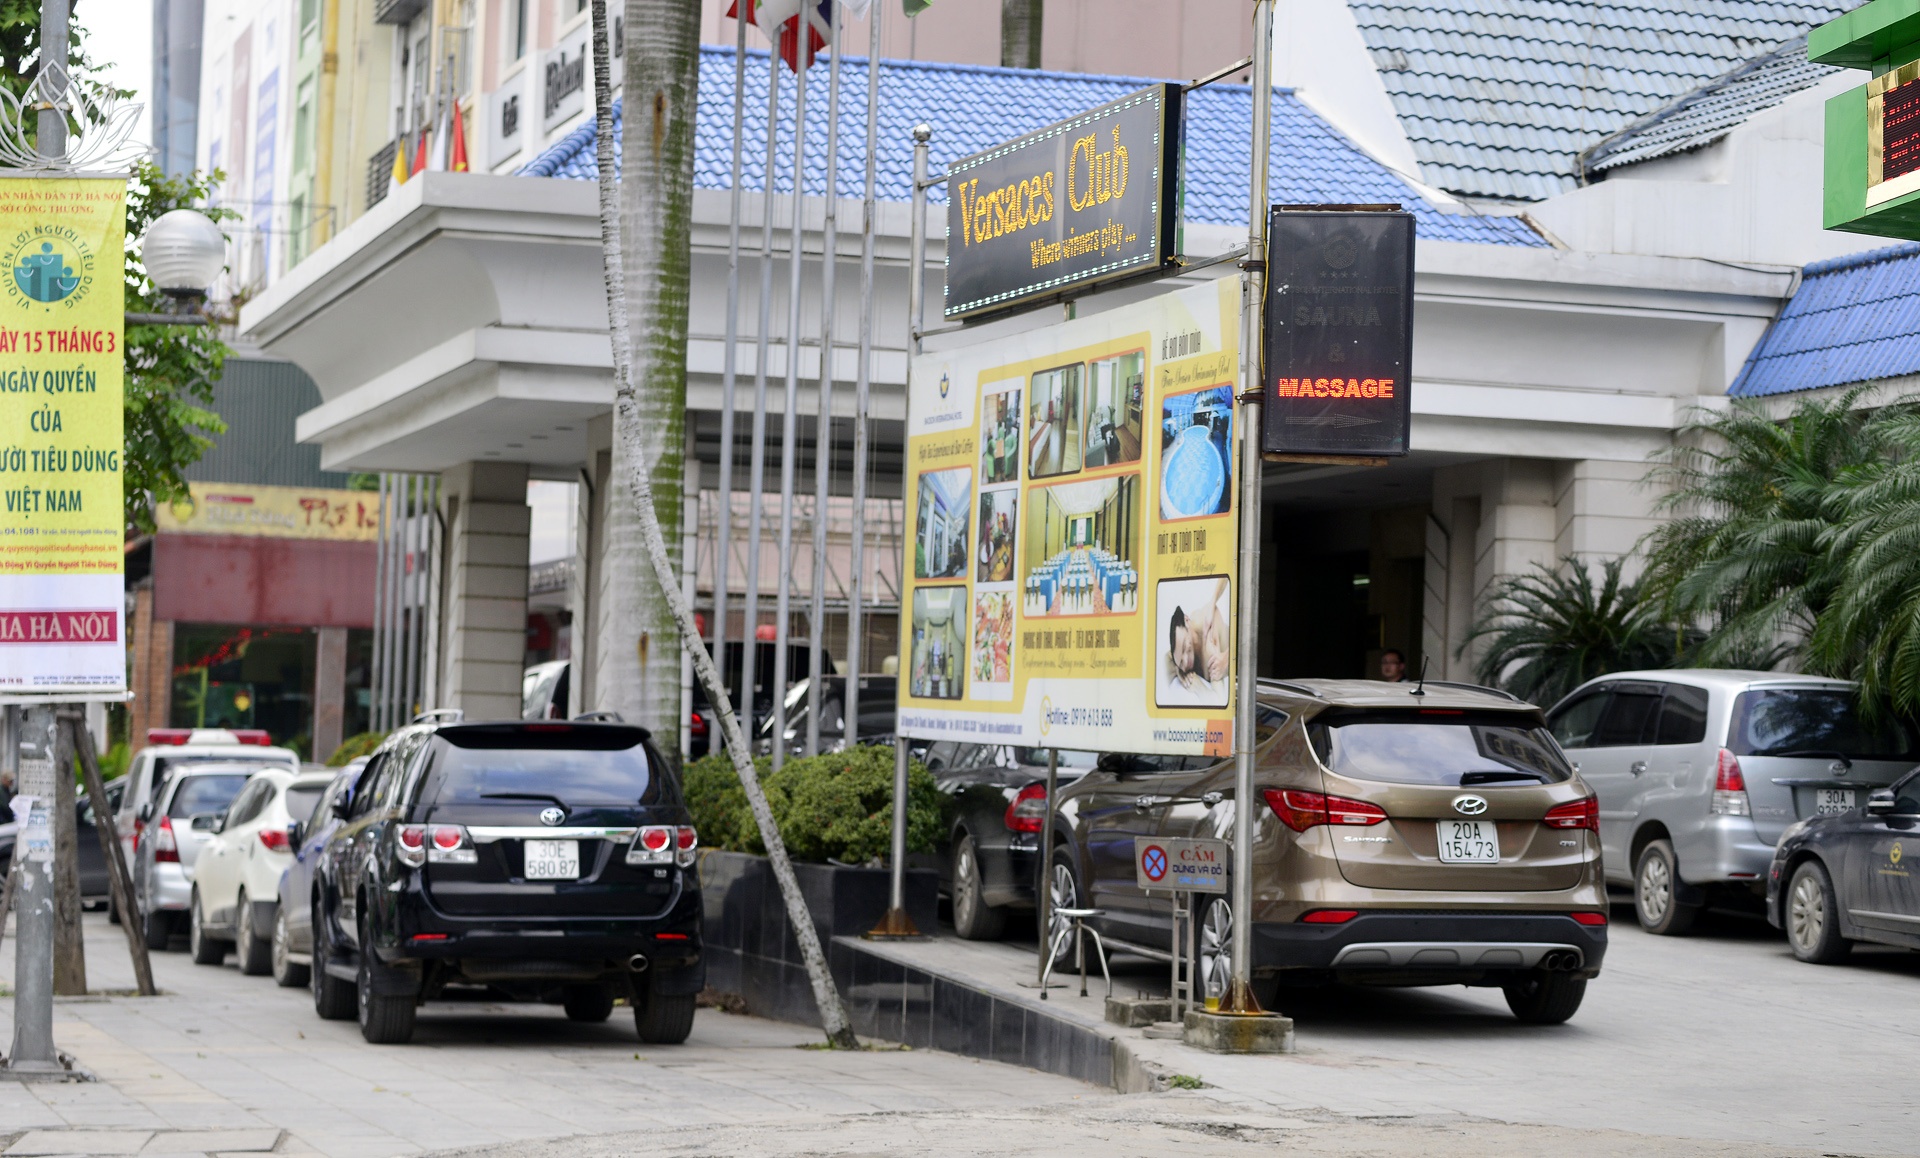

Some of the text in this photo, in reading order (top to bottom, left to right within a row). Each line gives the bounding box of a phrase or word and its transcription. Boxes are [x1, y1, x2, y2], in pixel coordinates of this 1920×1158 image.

[958, 123, 1129, 248] Versaces Club
[1030, 238, 1061, 269] Where
[1062, 226, 1100, 259] winners
[1294, 306, 1382, 326] SAUNA
[23, 331, 42, 353] 15
[47, 325, 103, 353] THÁNG
[107, 331, 116, 353] 3
[1279, 378, 1394, 399] MASSAGE
[30, 403, 62, 432] CỦA
[31, 445, 67, 472] TIÊU
[72, 445, 118, 472] DÙNG
[5, 485, 82, 519] VIỆT NAM
[30, 612, 64, 640] HÀ
[69, 612, 110, 642] NỘI
[1071, 708, 1086, 725] 0919
[1088, 708, 1099, 726] 613
[1101, 708, 1113, 727] 858
[1826, 790, 1846, 804] 30A
[1453, 823, 1481, 839] 20A
[540, 841, 566, 858] 30E
[1180, 844, 1216, 862] CẤM
[1446, 842, 1495, 858] 154.73
